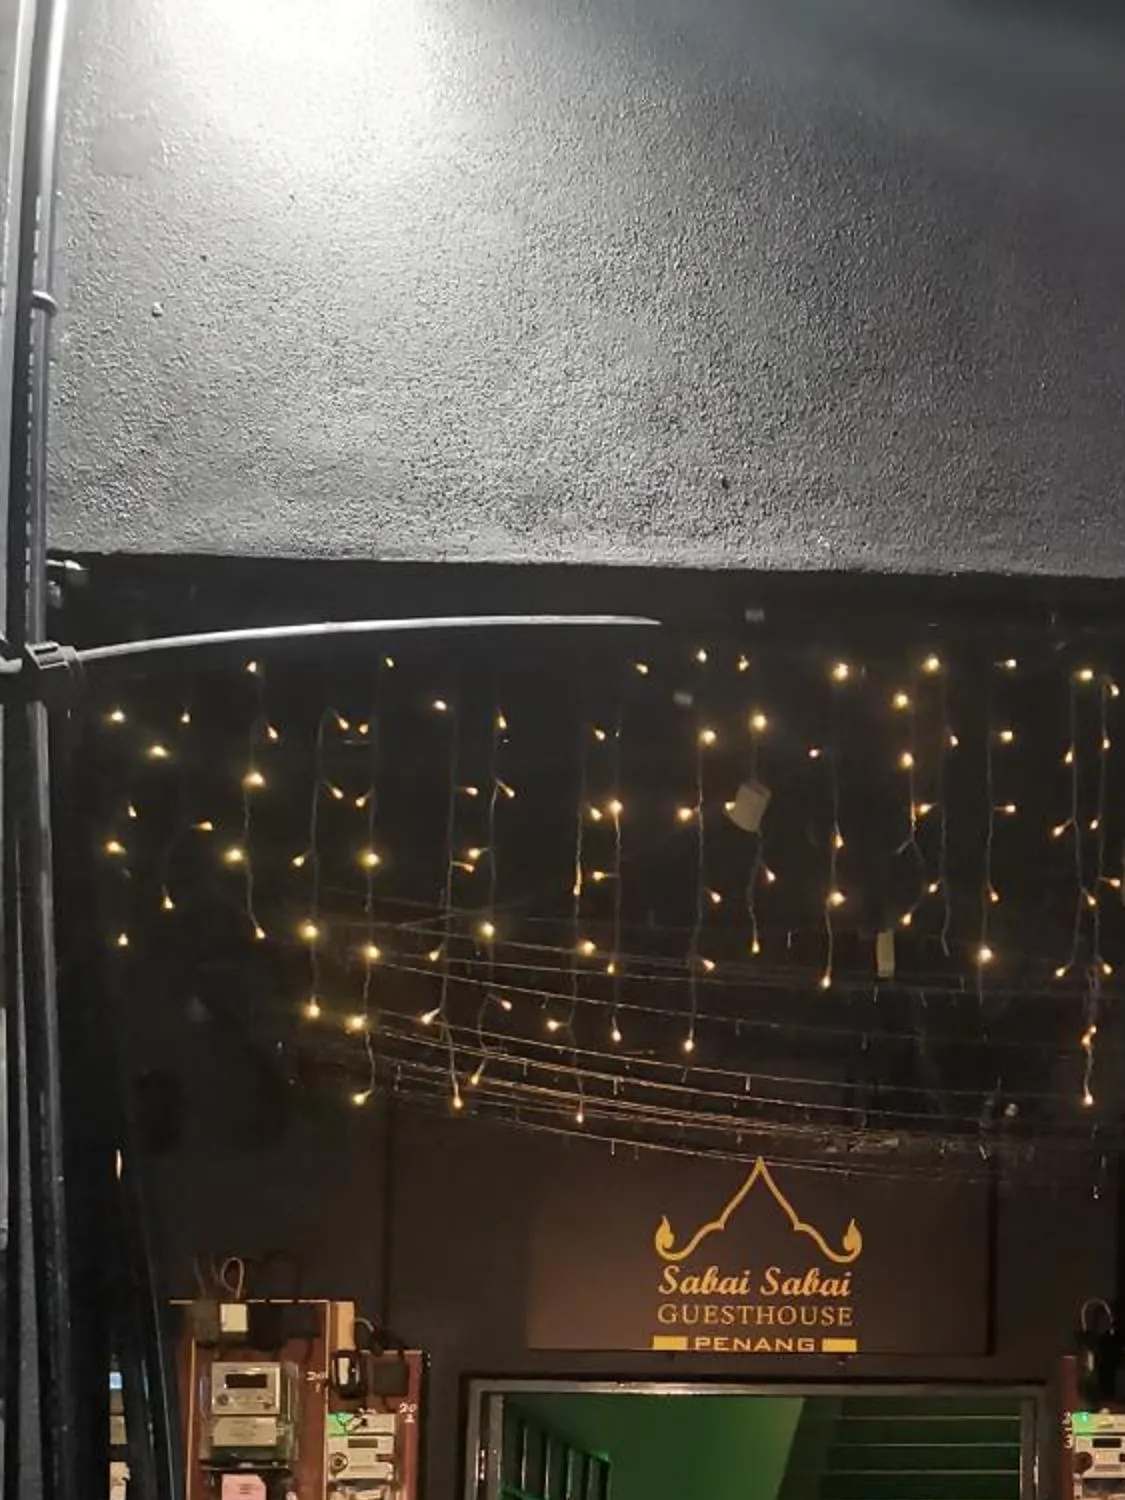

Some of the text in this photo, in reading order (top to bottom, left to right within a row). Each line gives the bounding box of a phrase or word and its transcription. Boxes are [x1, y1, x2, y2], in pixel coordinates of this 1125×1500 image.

[658, 1265, 852, 1297] Sabai Sabai
[657, 1303, 853, 1327] GUESTHOUSE
[694, 1336, 815, 1352] PENANG
